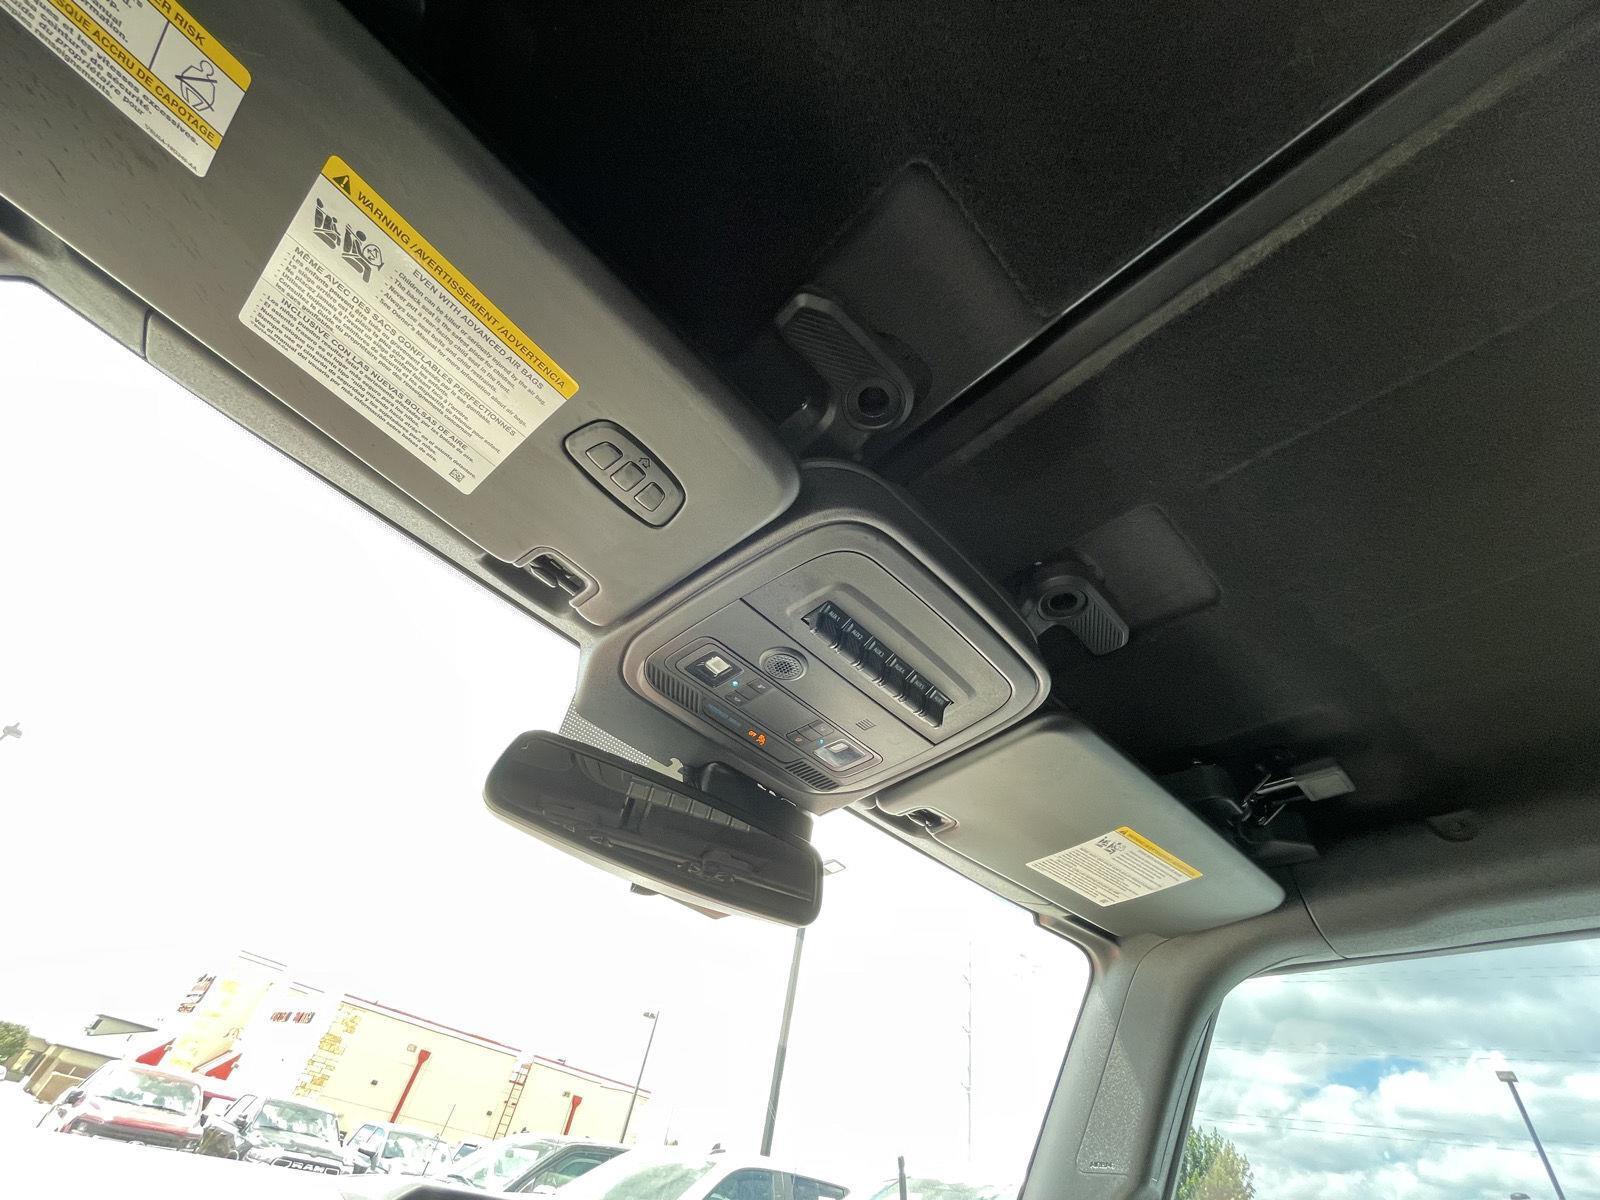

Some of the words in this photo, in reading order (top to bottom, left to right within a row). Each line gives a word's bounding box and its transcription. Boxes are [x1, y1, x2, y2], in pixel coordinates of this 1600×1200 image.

[174, 12, 206, 46] RISK
[92, 30, 135, 70] ACCRU
[136, 69, 153, 87] DE
[155, 85, 215, 142] CAPOTAGE
[96, 52, 139, 93] vitesses
[142, 94, 198, 146] excessives.
[122, 96, 144, 116] pour
[355, 190, 411, 245] WARNING
[280, 297, 330, 340] INCLUSIVE
[330, 337, 351, 357] CON
[351, 354, 370, 372] LAS
[369, 369, 404, 400] NUEVAS
[403, 397, 437, 426] BOLSAS
[436, 424, 449, 436] DE
[448, 433, 468, 450] AIRE
[293, 244, 325, 274] MÊME
[323, 270, 351, 297] AVEC
[350, 293, 372, 314] DES
[371, 311, 398, 336] SACS
[396, 332, 454, 384] GONFLABLES
[452, 380, 517, 437] PERFECTIONNÉS
[411, 268, 438, 295] EVEN
[437, 291, 462, 315] WITH
[459, 312, 507, 356] ADVANCED
[505, 353, 521, 369] AIR
[519, 367, 544, 390] BAGS
[291, 1161, 325, 1174] RAM
